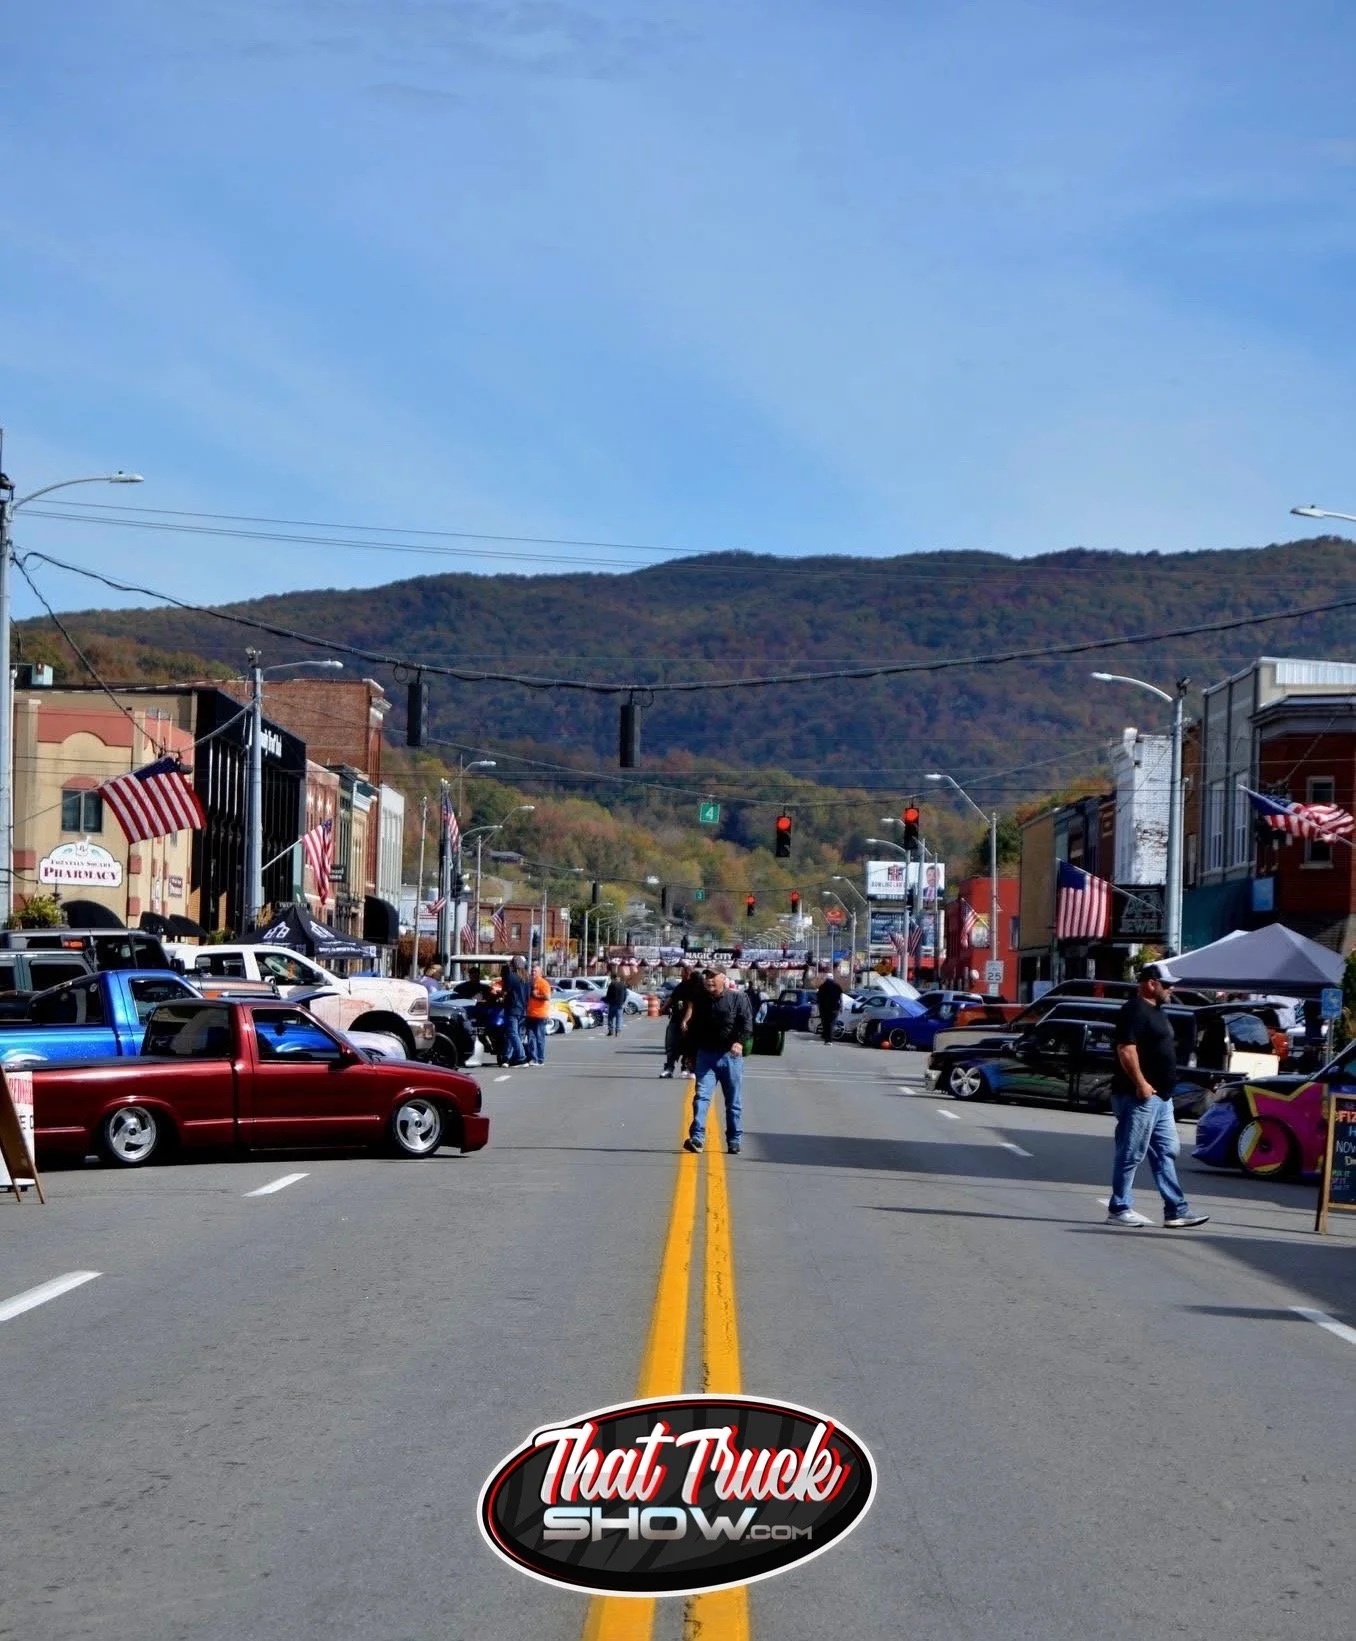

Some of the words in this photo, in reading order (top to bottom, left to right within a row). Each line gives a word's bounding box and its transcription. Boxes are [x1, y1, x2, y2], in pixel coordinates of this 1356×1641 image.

[705, 806, 714, 820] 4
[44, 867, 116, 880] PHARMACY
[685, 952, 712, 960] MAGIC
[713, 952, 734, 960] CITY
[988, 972, 1001, 981] 25
